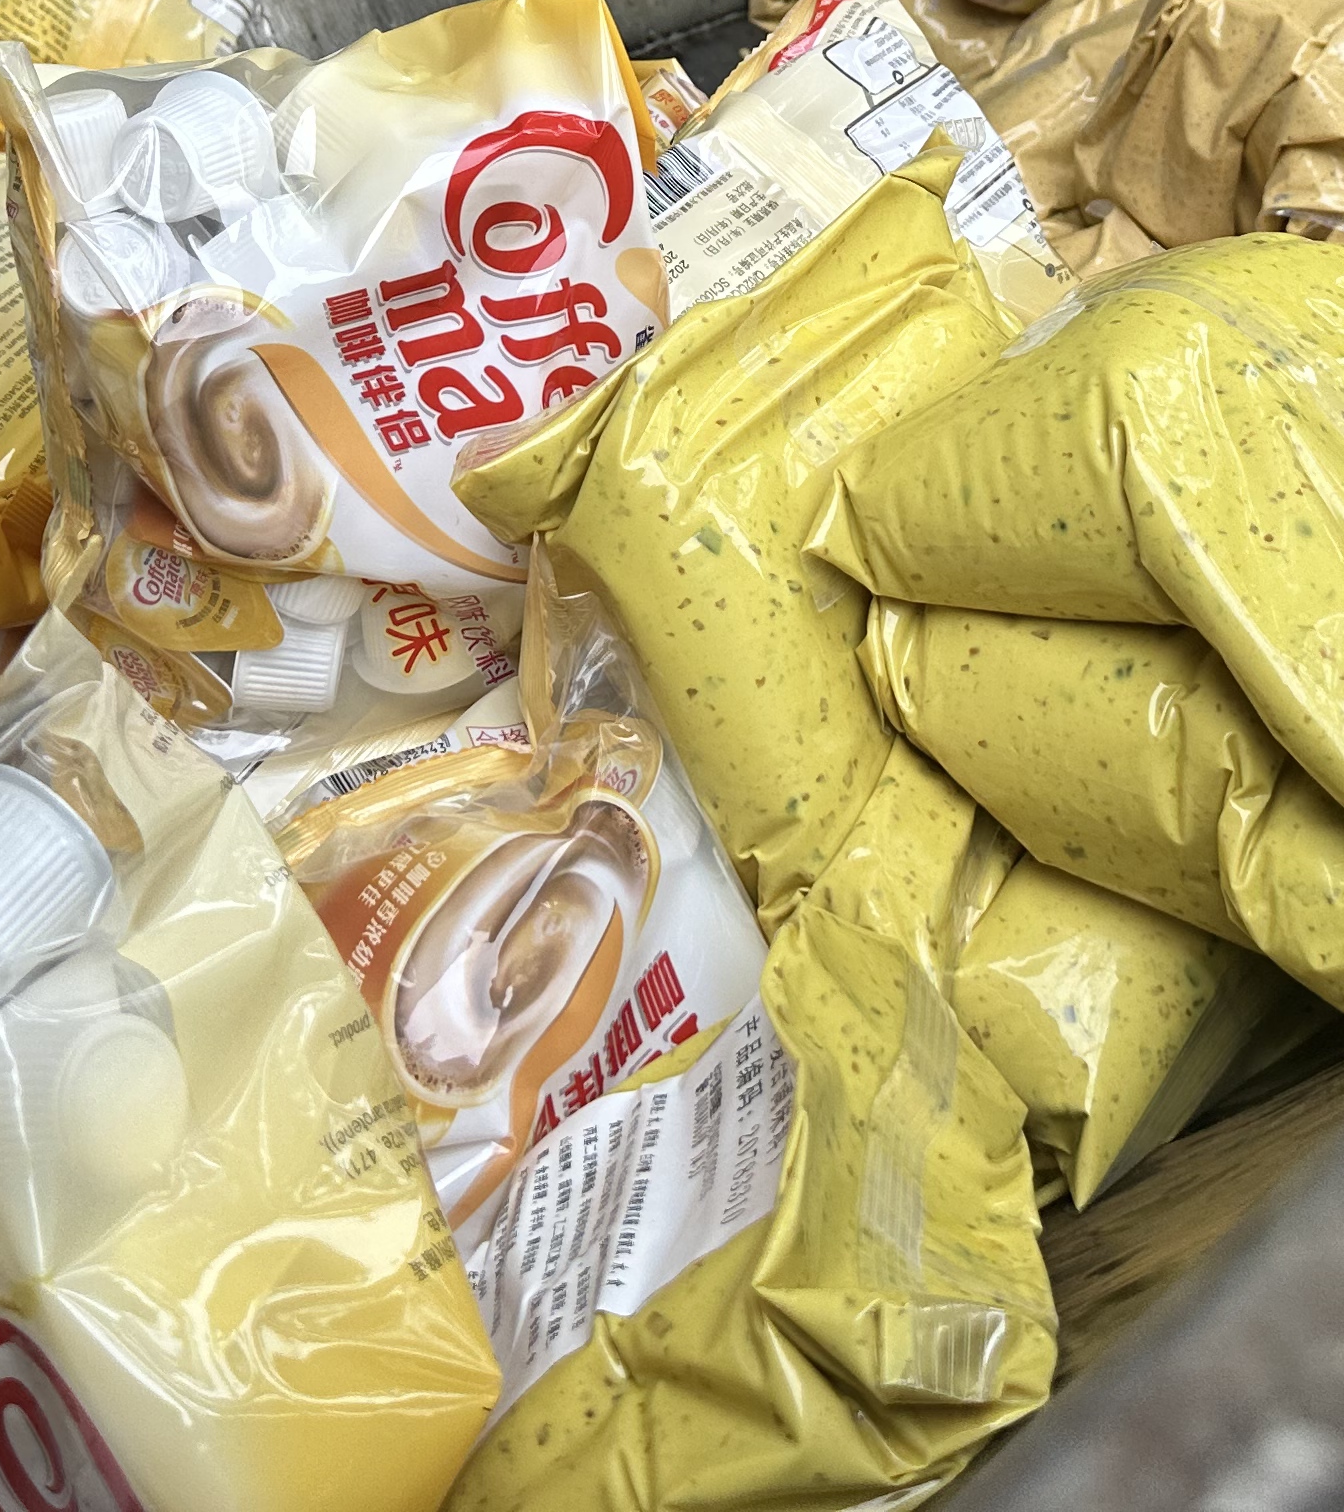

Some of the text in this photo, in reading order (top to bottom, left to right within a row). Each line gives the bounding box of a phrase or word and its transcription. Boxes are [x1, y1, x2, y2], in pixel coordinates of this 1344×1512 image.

[443, 110, 635, 410] Coffe
[325, 288, 432, 455] 咖啡伴侣
[380, 258, 528, 443] ma
[133, 548, 168, 605] Coffee
[163, 555, 182, 600] mate
[443, 594, 517, 687] 风味饮料
[358, 841, 431, 907] 口感更佳
[735, 1015, 764, 1122] 产品编码：
